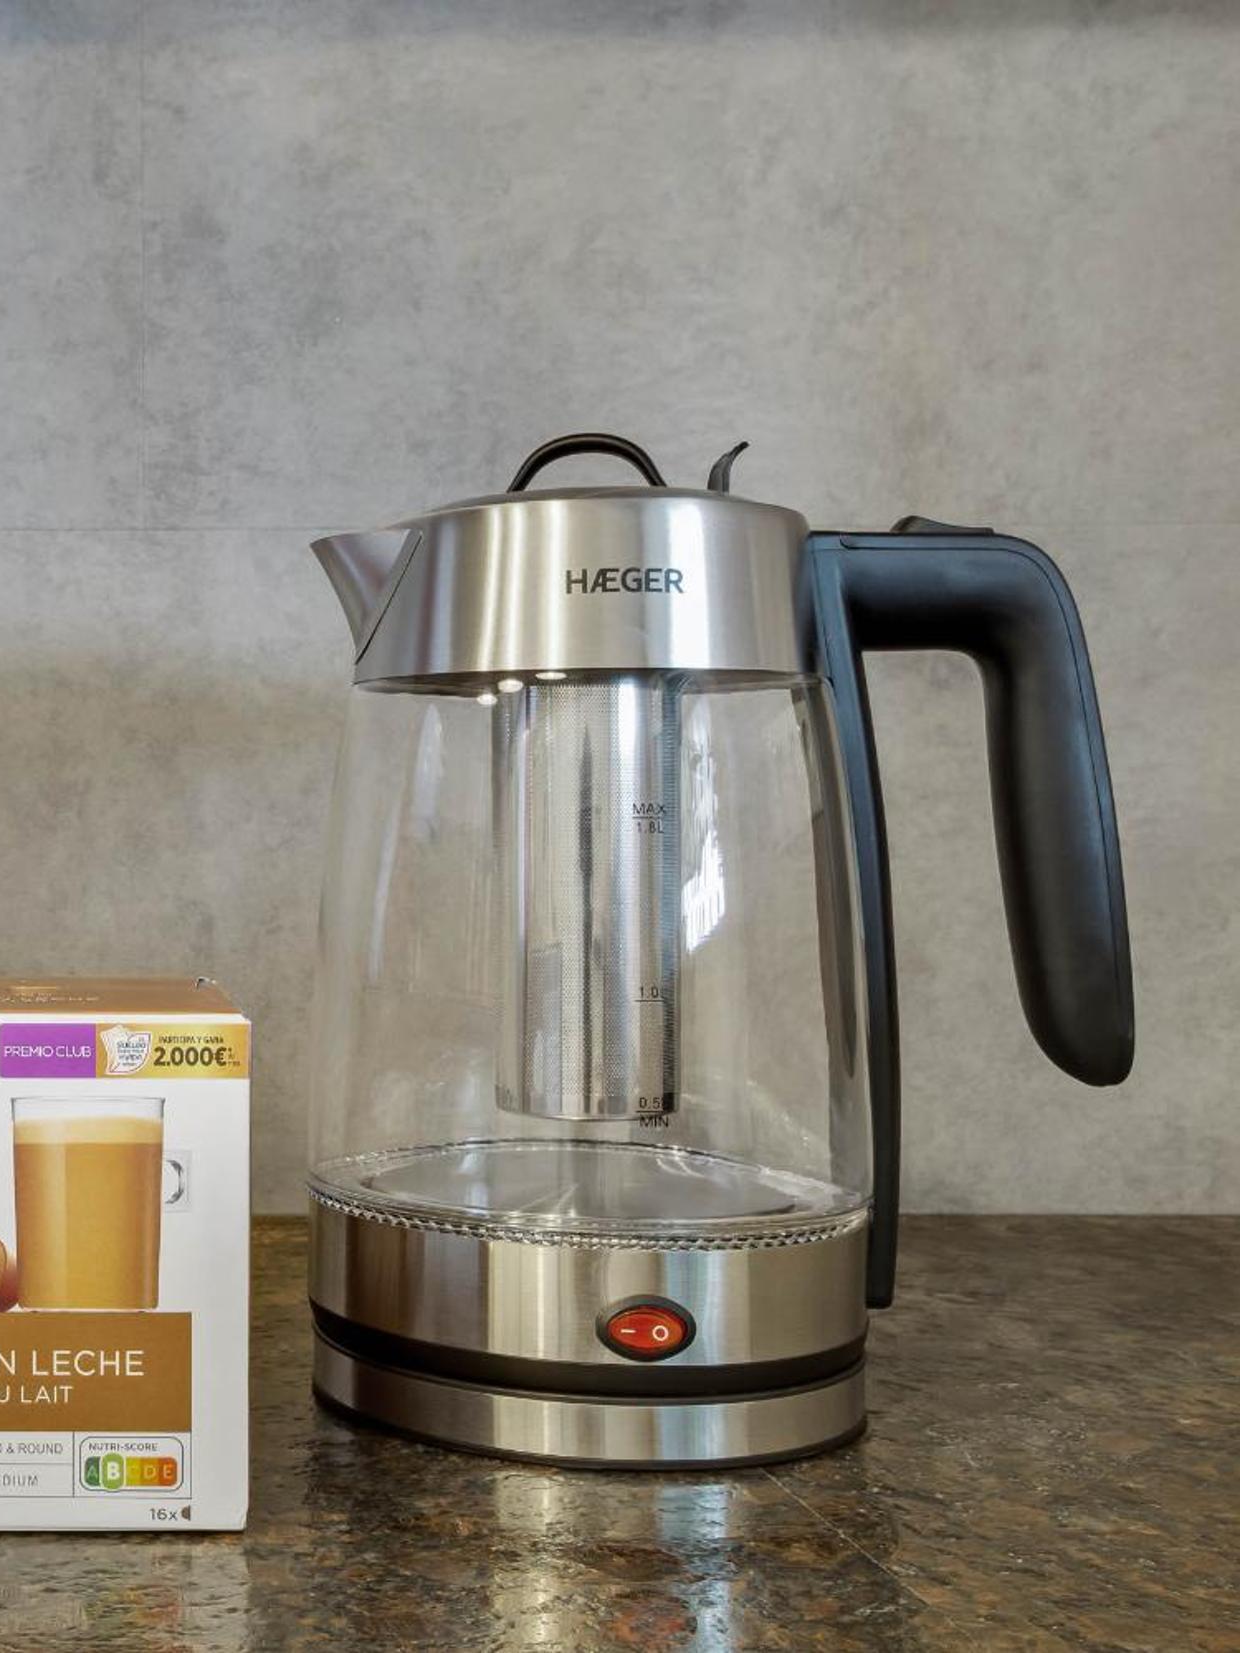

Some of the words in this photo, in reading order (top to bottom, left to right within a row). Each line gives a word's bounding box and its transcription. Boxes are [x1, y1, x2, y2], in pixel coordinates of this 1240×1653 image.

[632, 802, 666, 815] MAX
[3, 1046, 54, 1058] PREMIO
[56, 1046, 91, 1057] CLUB
[639, 1115, 669, 1129] MIN
[32, 1350, 145, 1376] LECHE
[20, 1386, 74, 1403] LAIT
[6, 1442, 15, 1454] &
[18, 1442, 64, 1455] ROUND
[88, 1442, 158, 1452] NUTRI-SCORE
[86, 1464, 98, 1479] A
[106, 1461, 120, 1481] B
[144, 1465, 157, 1480] D
[163, 1464, 174, 1480] E
[149, 1508, 178, 1521] 16x
